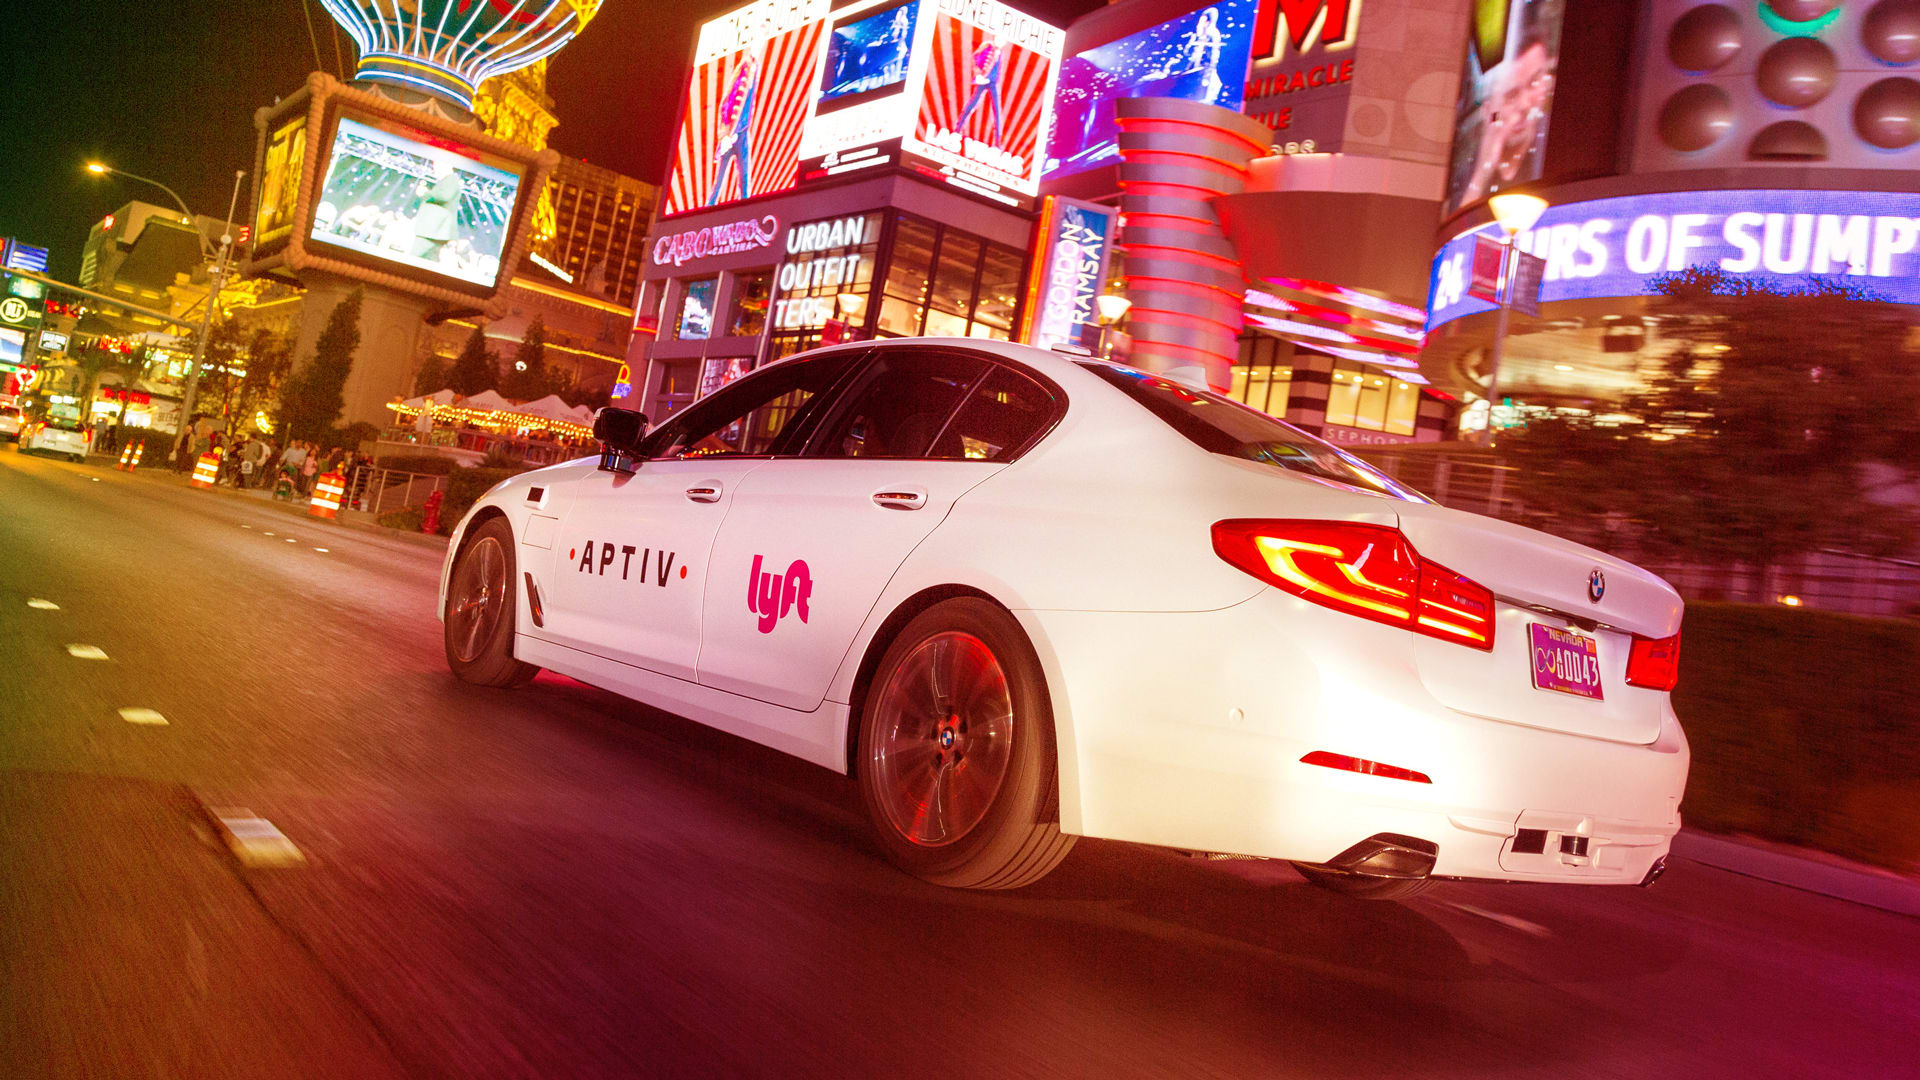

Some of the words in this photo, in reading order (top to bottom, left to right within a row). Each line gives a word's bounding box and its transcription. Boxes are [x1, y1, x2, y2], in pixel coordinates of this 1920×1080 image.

[1002, 11, 1055, 55] RICHIE
[1243, 59, 1353, 100] MIRACLE
[924, 122, 962, 153] LAS
[1251, 107, 1292, 130] ILE
[653, 228, 712, 267] CABO
[711, 215, 777, 247] WABO
[787, 216, 864, 254] URBAN
[1625, 213, 1709, 274] OF
[1719, 212, 1920, 278] SUMP
[780, 254, 860, 291] OUTFIT
[1047, 222, 1083, 321] GORDON
[1071, 227, 1104, 325] RAMSAY
[775, 296, 826, 328] TERS
[1327, 428, 1410, 445] SEPHOR
[579, 540, 675, 588] APTIV
[1549, 628, 1583, 647] NEVADA
